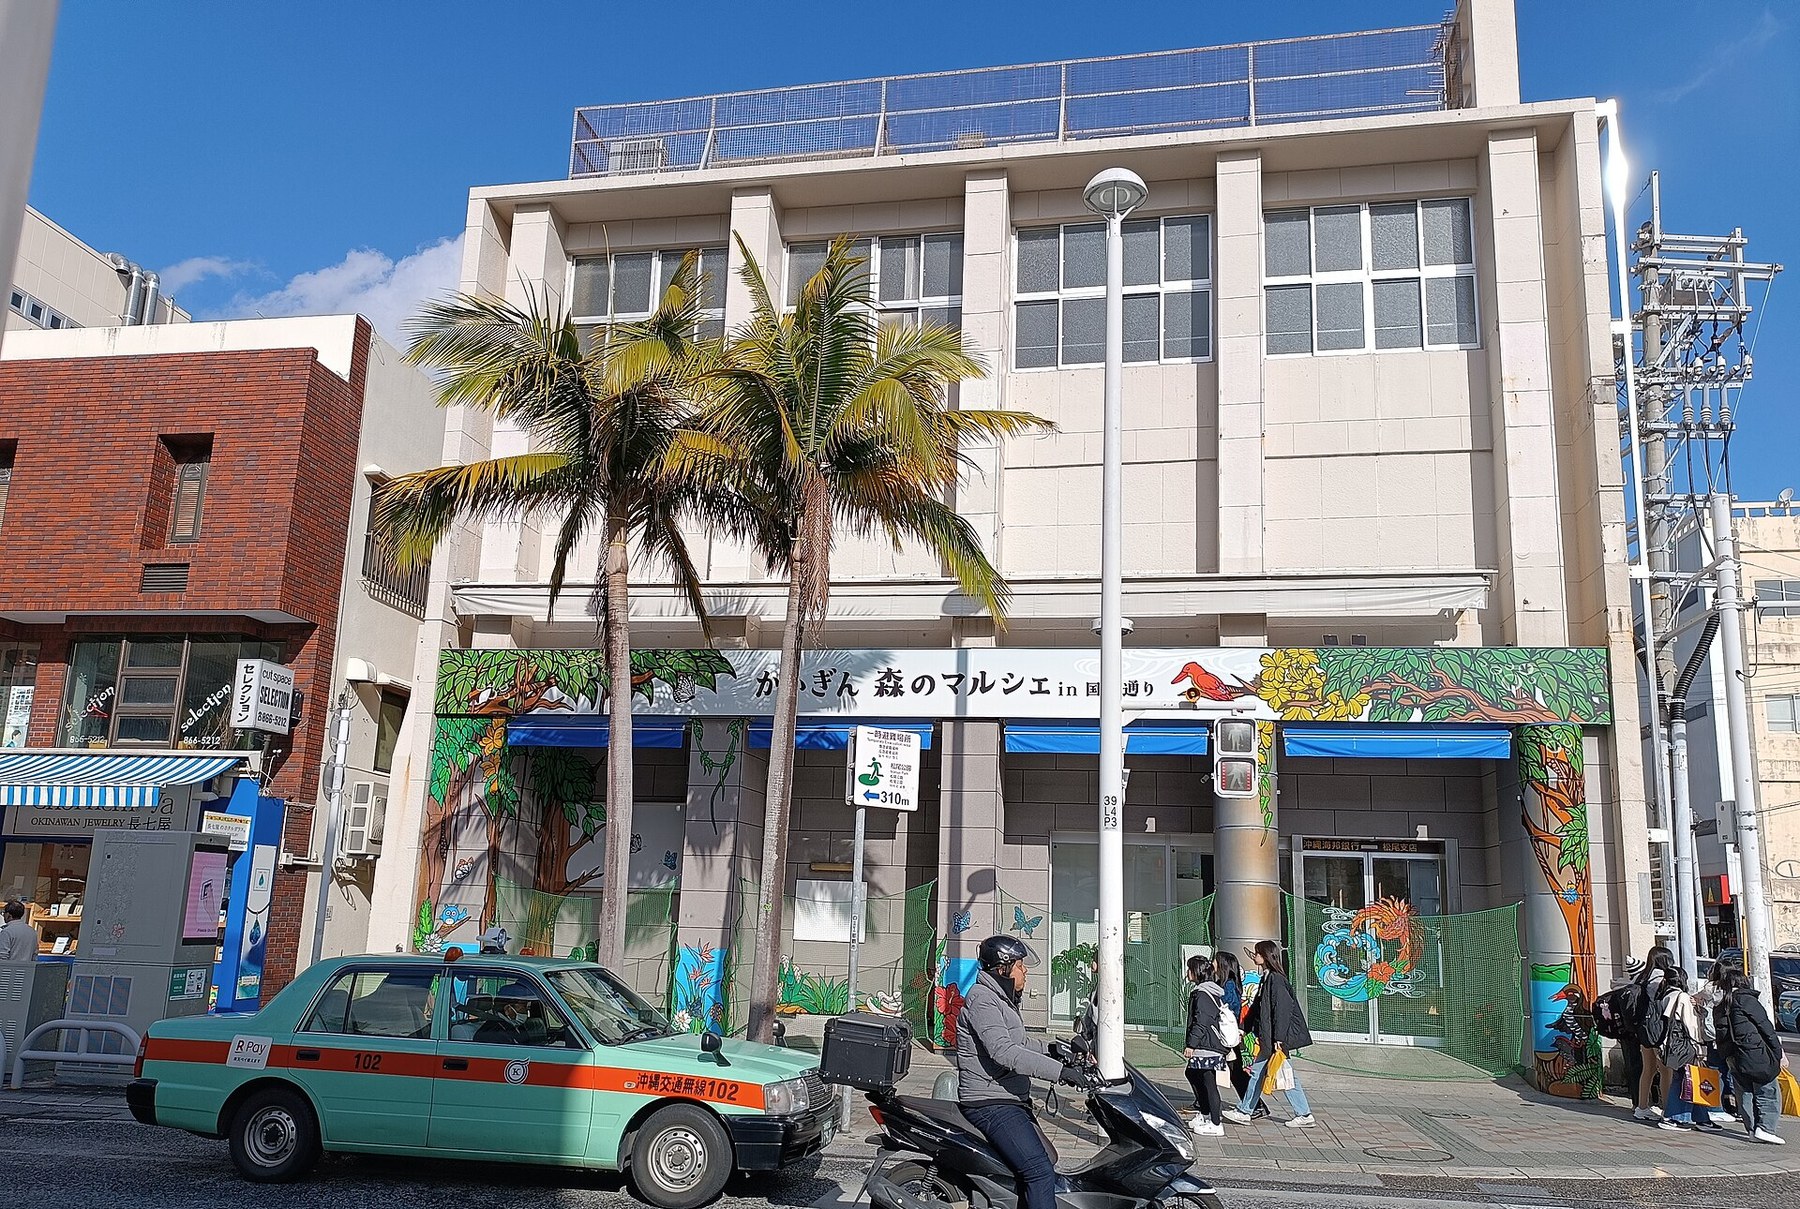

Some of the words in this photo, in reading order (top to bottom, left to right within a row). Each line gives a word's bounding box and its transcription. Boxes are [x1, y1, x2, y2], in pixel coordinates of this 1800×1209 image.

[262, 669, 273, 681] cut
[273, 672, 292, 686] space
[237, 664, 255, 722] セレクション
[1058, 681, 1077, 697] in
[1086, 680, 1154, 698] 国通り
[259, 685, 291, 710] SELECTION
[180, 683, 232, 733] selection
[69, 735, 105, 744] 866-5212
[183, 736, 221, 745] 866-5212
[880, 790, 910, 806] 310m
[1103, 795, 1118, 806] 39
[1104, 806, 1117, 817] L4
[30, 817, 81, 828] OKINAWAN
[83, 818, 126, 828] JEWELRY
[127, 816, 172, 831] 長七屋
[1103, 816, 1118, 828] P3
[1303, 839, 1360, 851] 沖縄海邦銀行
[1382, 842, 1418, 852] 松尾支店
[246, 1041, 267, 1056] Pay
[354, 1052, 382, 1071] 102
